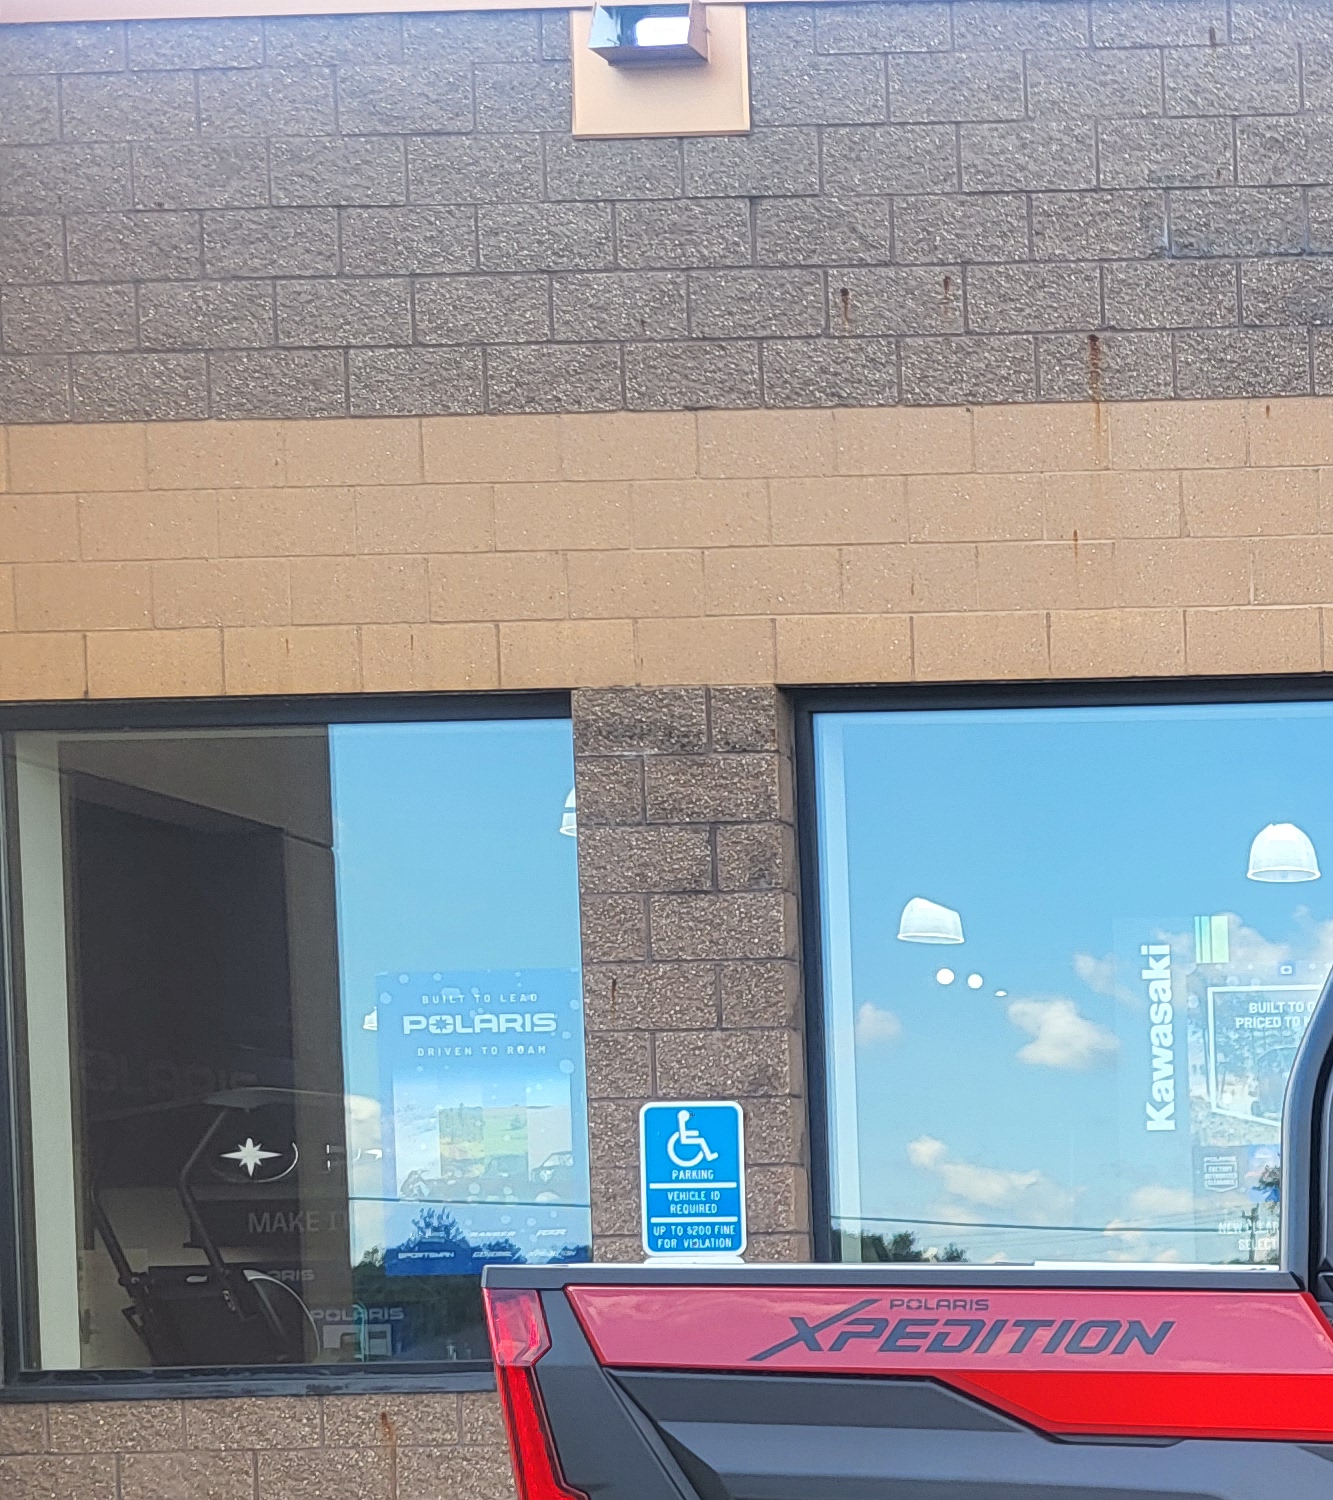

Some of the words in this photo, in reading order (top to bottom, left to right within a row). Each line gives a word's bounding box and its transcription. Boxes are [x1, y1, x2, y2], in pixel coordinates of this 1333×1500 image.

[421, 994, 465, 1004] BUILT
[473, 994, 491, 1003] TO
[500, 993, 538, 1003] LEAD
[1249, 1001, 1284, 1014] BUILT
[1288, 1001, 1305, 1013] TO
[403, 1013, 557, 1034] POLARIS
[1234, 1016, 1281, 1029] PRICED
[1284, 1016, 1301, 1028] TO
[1141, 944, 1176, 1131] Kawasaki
[417, 1047, 472, 1057] DRIVEN
[482, 1046, 498, 1056] TO
[507, 1045, 547, 1055] ROAM
[672, 1169, 714, 1180] PARKING
[667, 1191, 706, 1201] VEHICLE
[711, 1191, 721, 1200] ID
[670, 1203, 718, 1214] REQUIRED
[248, 1212, 319, 1233] MAKE
[653, 1226, 666, 1236] UP
[670, 1226, 684, 1236] TO
[686, 1225, 712, 1236] $200
[714, 1224, 736, 1235] FINE
[657, 1238, 677, 1248] FOR
[683, 1237, 732, 1248] VIOLATION
[889, 1298, 989, 1312] POLARIS
[310, 1307, 405, 1321] POLARIS
[746, 1298, 1176, 1361] XPEDITION
